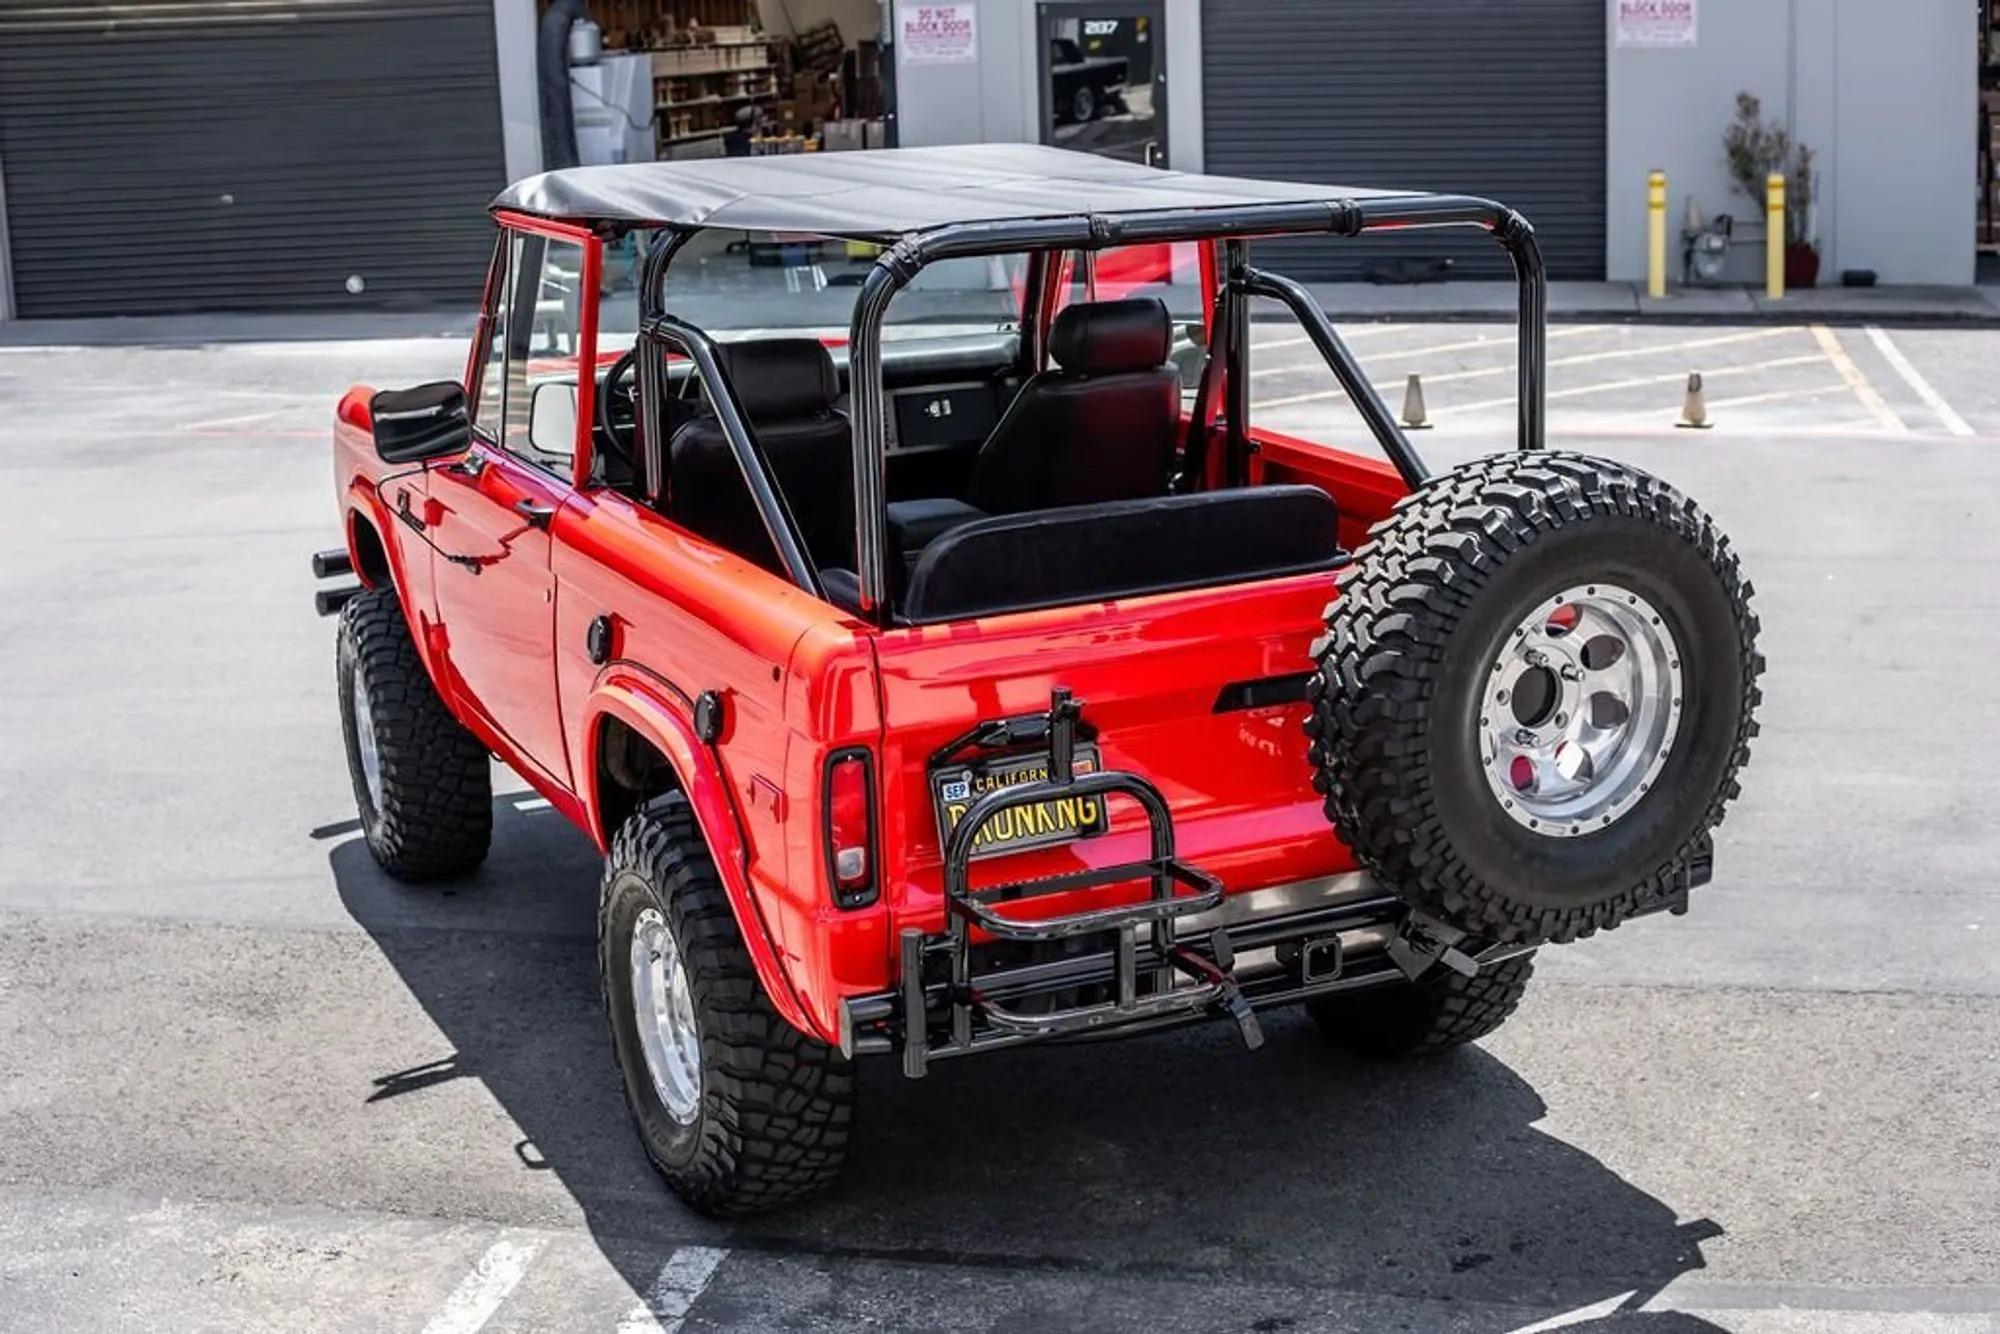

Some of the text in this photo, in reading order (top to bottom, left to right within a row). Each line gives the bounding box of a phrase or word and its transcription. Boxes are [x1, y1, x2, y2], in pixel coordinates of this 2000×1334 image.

[918, 7, 955, 19] DO NOT
[1621, 3, 1691, 14] BLOCK DOOR
[905, 20, 970, 33] BLOCK DOOR
[976, 768, 1048, 791] CALIFORN
[946, 784, 966, 798] SEP
